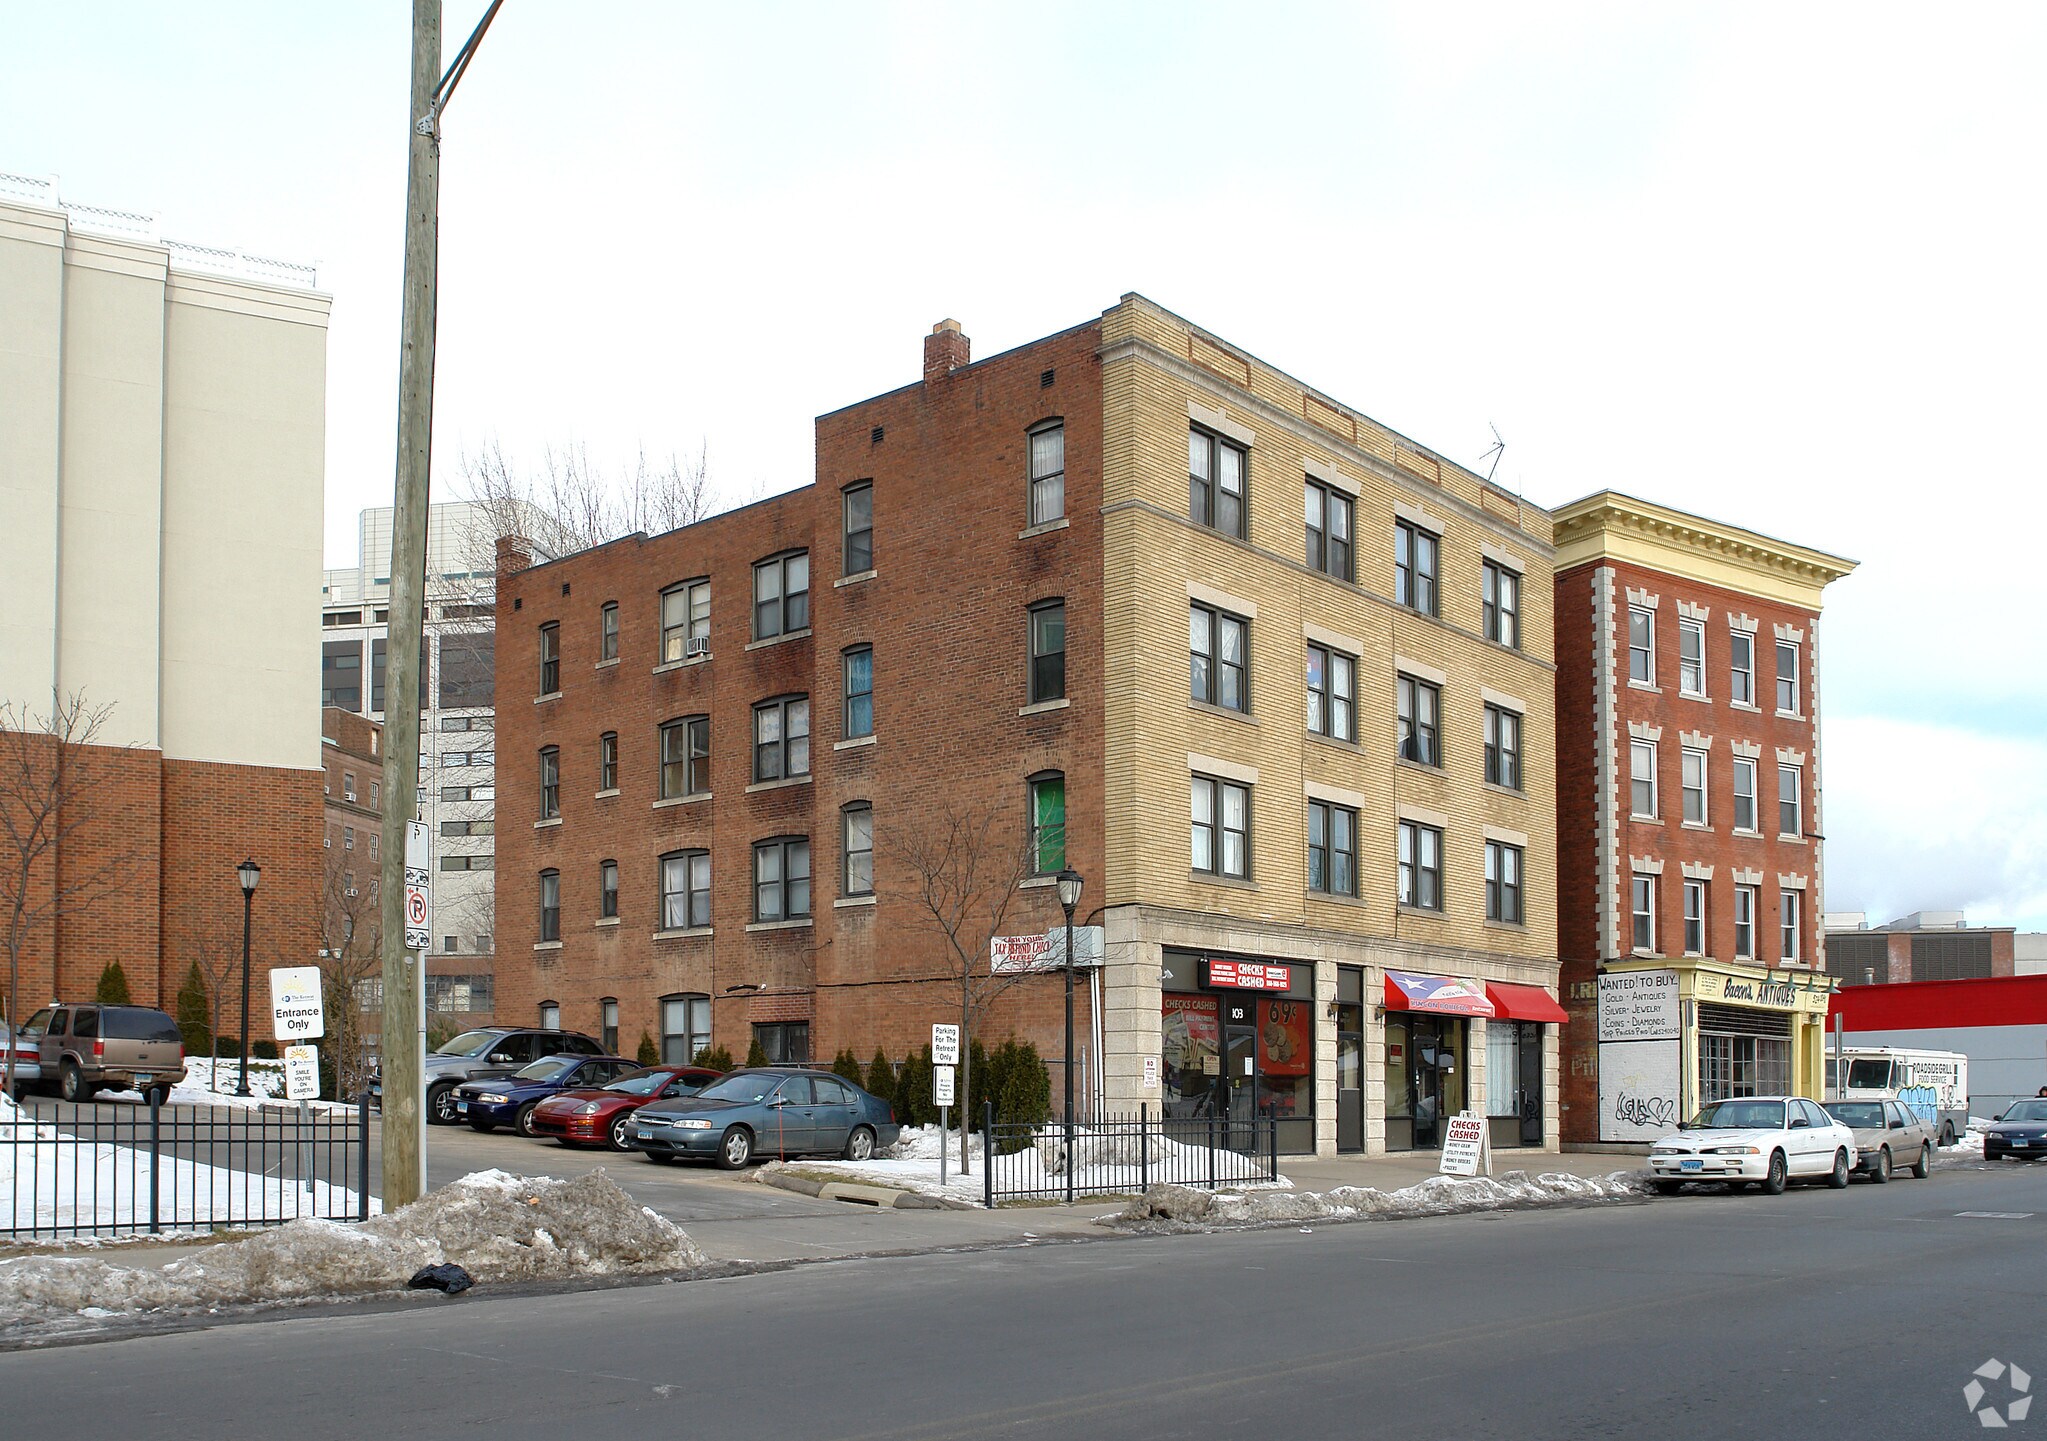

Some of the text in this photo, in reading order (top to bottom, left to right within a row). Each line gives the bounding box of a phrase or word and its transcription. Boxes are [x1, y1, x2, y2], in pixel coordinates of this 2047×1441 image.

[995, 943, 1007, 955] TAX
[1237, 963, 1264, 976] CHECKS
[1237, 975, 1265, 988] CASHED
[1640, 977, 1653, 988] TO
[1605, 991, 1666, 1002] GOLD ANTIQUES
[1755, 983, 1796, 1006] ANTIQUES
[1164, 999, 1217, 1011] CHECKS CASHED
[1604, 1003, 1662, 1015] SILVER JEWELRY
[275, 1008, 319, 1019] Entrance
[1231, 1007, 1245, 1020] 103
[287, 1019, 310, 1030] Only
[1605, 1016, 1666, 1028] COINS DIAMONDS
[935, 1026, 956, 1036] Parking
[935, 1035, 957, 1043] For The
[935, 1044, 956, 1052] Retreat
[939, 1053, 952, 1061] Only
[1918, 1075, 1947, 1084] FOOD SERVICE
[1451, 1120, 1481, 1131] CHECKS
[1448, 1129, 1480, 1140] CASHED
